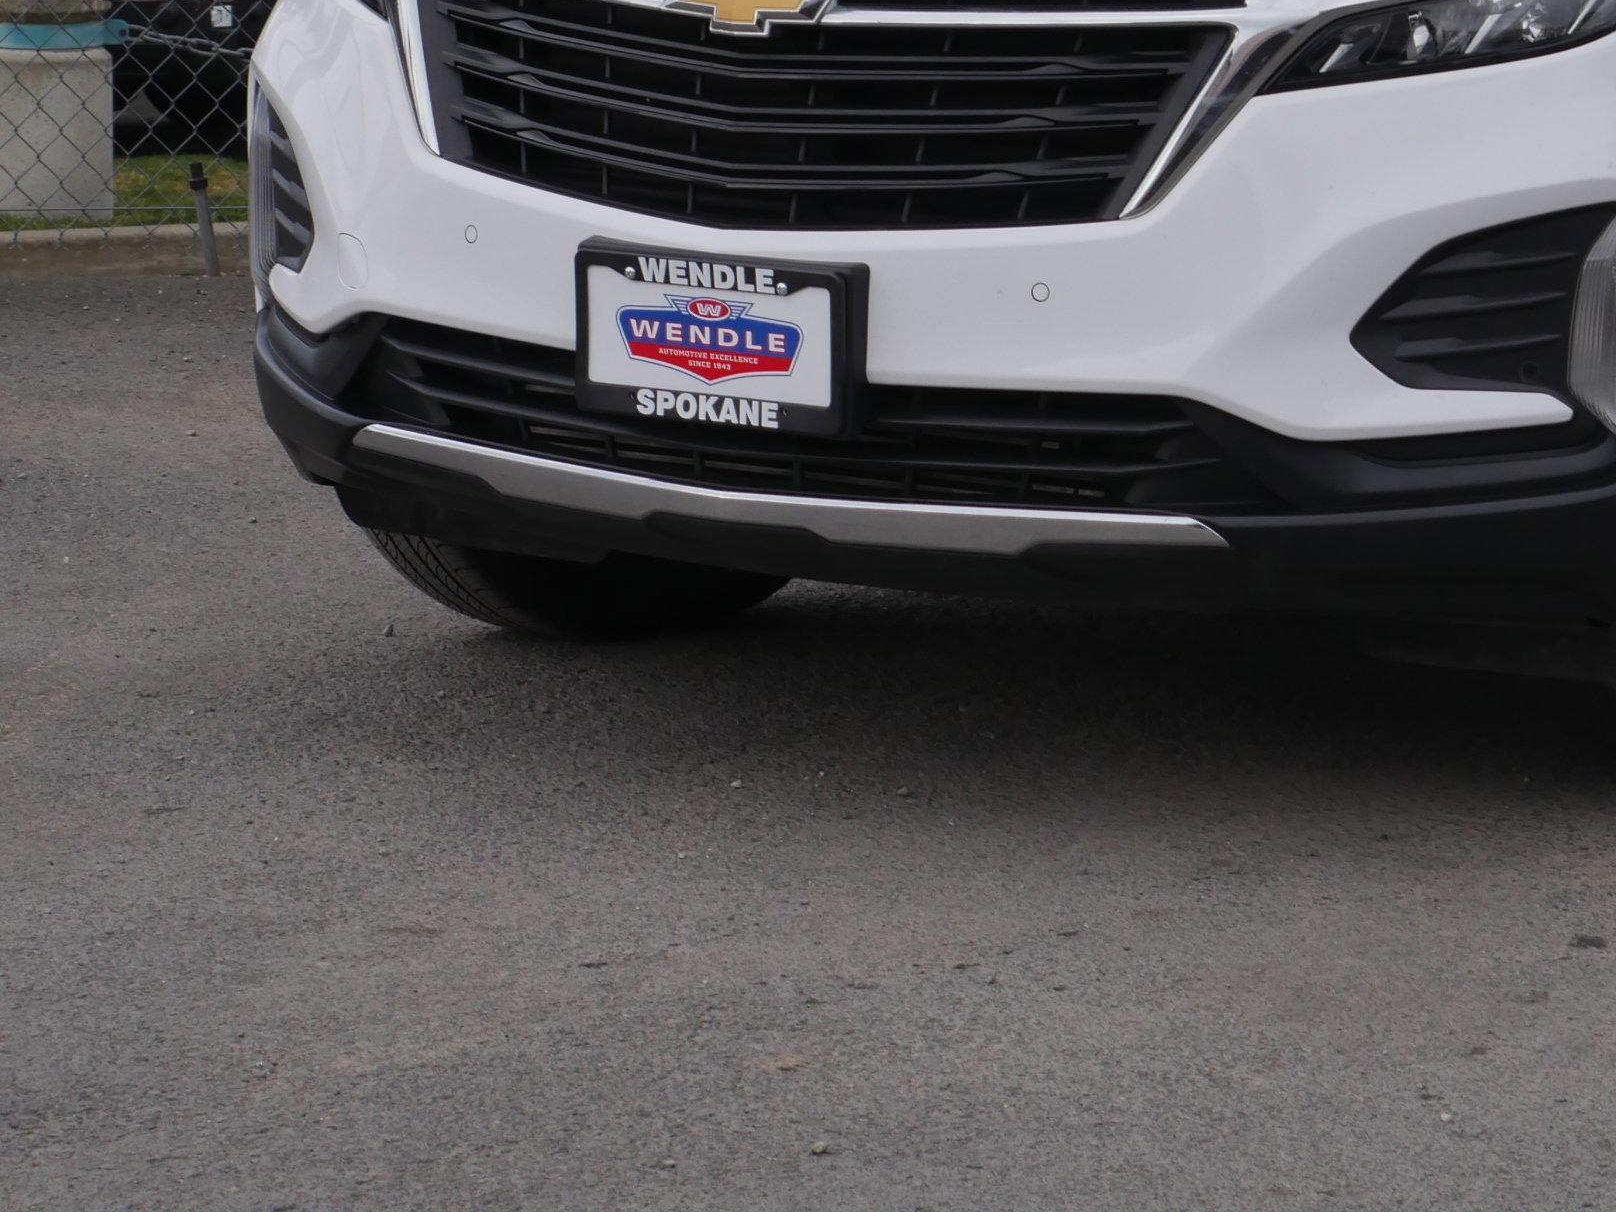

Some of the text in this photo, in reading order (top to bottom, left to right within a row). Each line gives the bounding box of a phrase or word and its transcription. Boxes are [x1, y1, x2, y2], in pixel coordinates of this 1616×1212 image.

[637, 256, 776, 294] WENDLE
[696, 302, 722, 317] W
[629, 318, 786, 353] WENDLE
[658, 347, 758, 364] AUTOMOTIVE EXCELLENCE
[688, 359, 731, 370] SINCE 1943
[636, 388, 779, 428] SPOKANE
